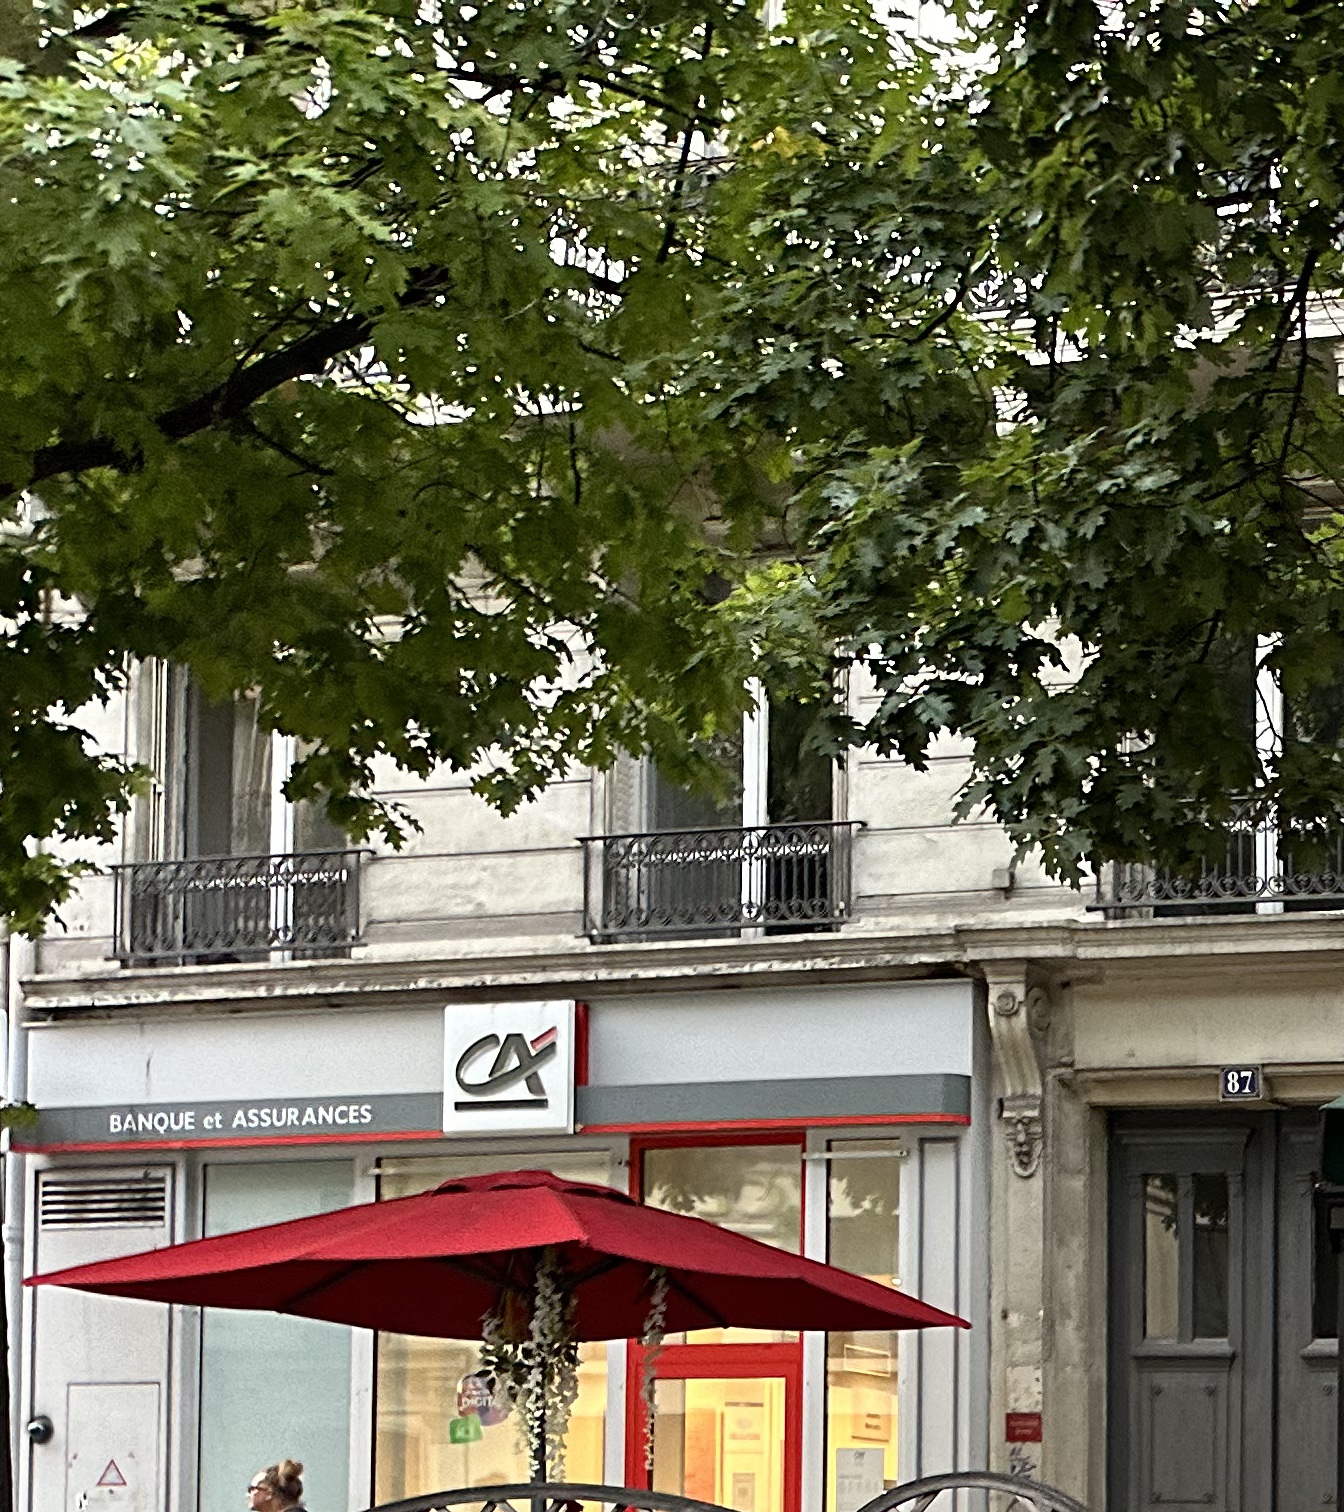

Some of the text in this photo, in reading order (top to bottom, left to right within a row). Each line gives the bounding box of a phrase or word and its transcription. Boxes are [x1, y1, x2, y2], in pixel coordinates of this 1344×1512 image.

[1227, 1070, 1253, 1094] 87
[109, 1104, 372, 1134] BANQUE et ASSURANCES
